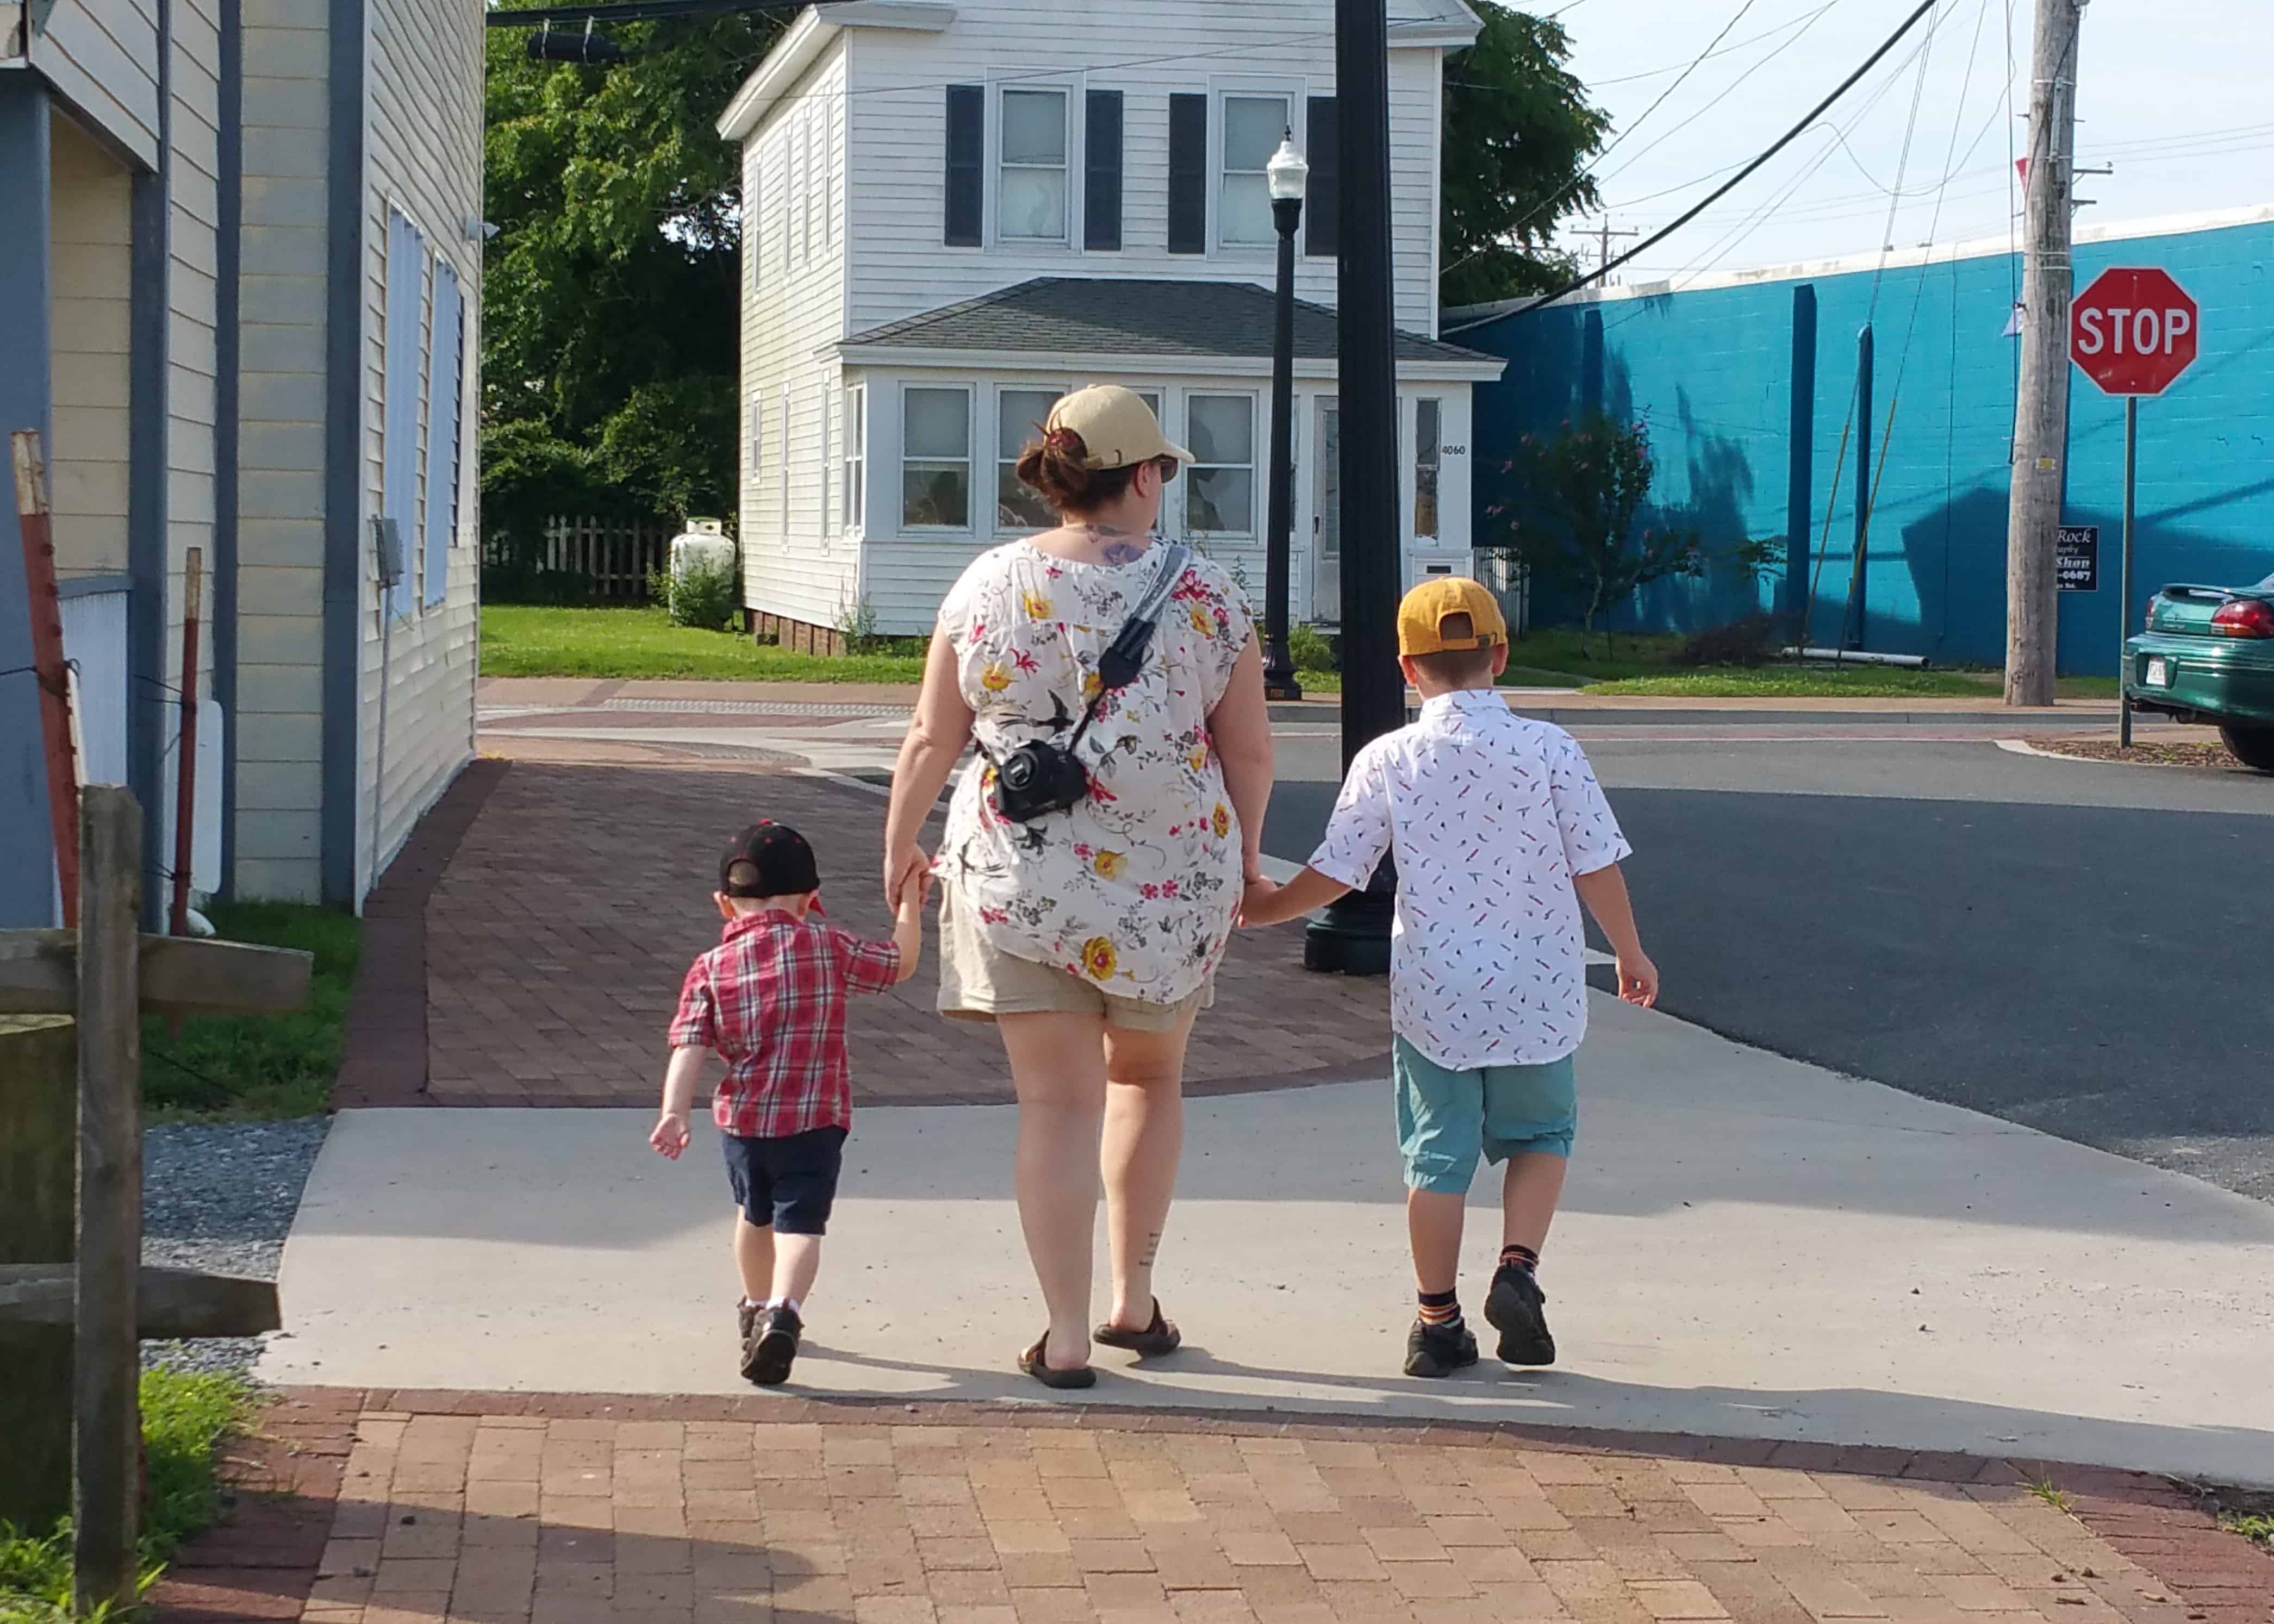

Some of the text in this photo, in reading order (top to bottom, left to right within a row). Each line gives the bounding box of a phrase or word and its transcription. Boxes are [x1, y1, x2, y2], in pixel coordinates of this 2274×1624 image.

[2078, 308, 2190, 354] STOP
[1443, 445, 1466, 455] 4060
[2058, 528, 2091, 543] Rock
